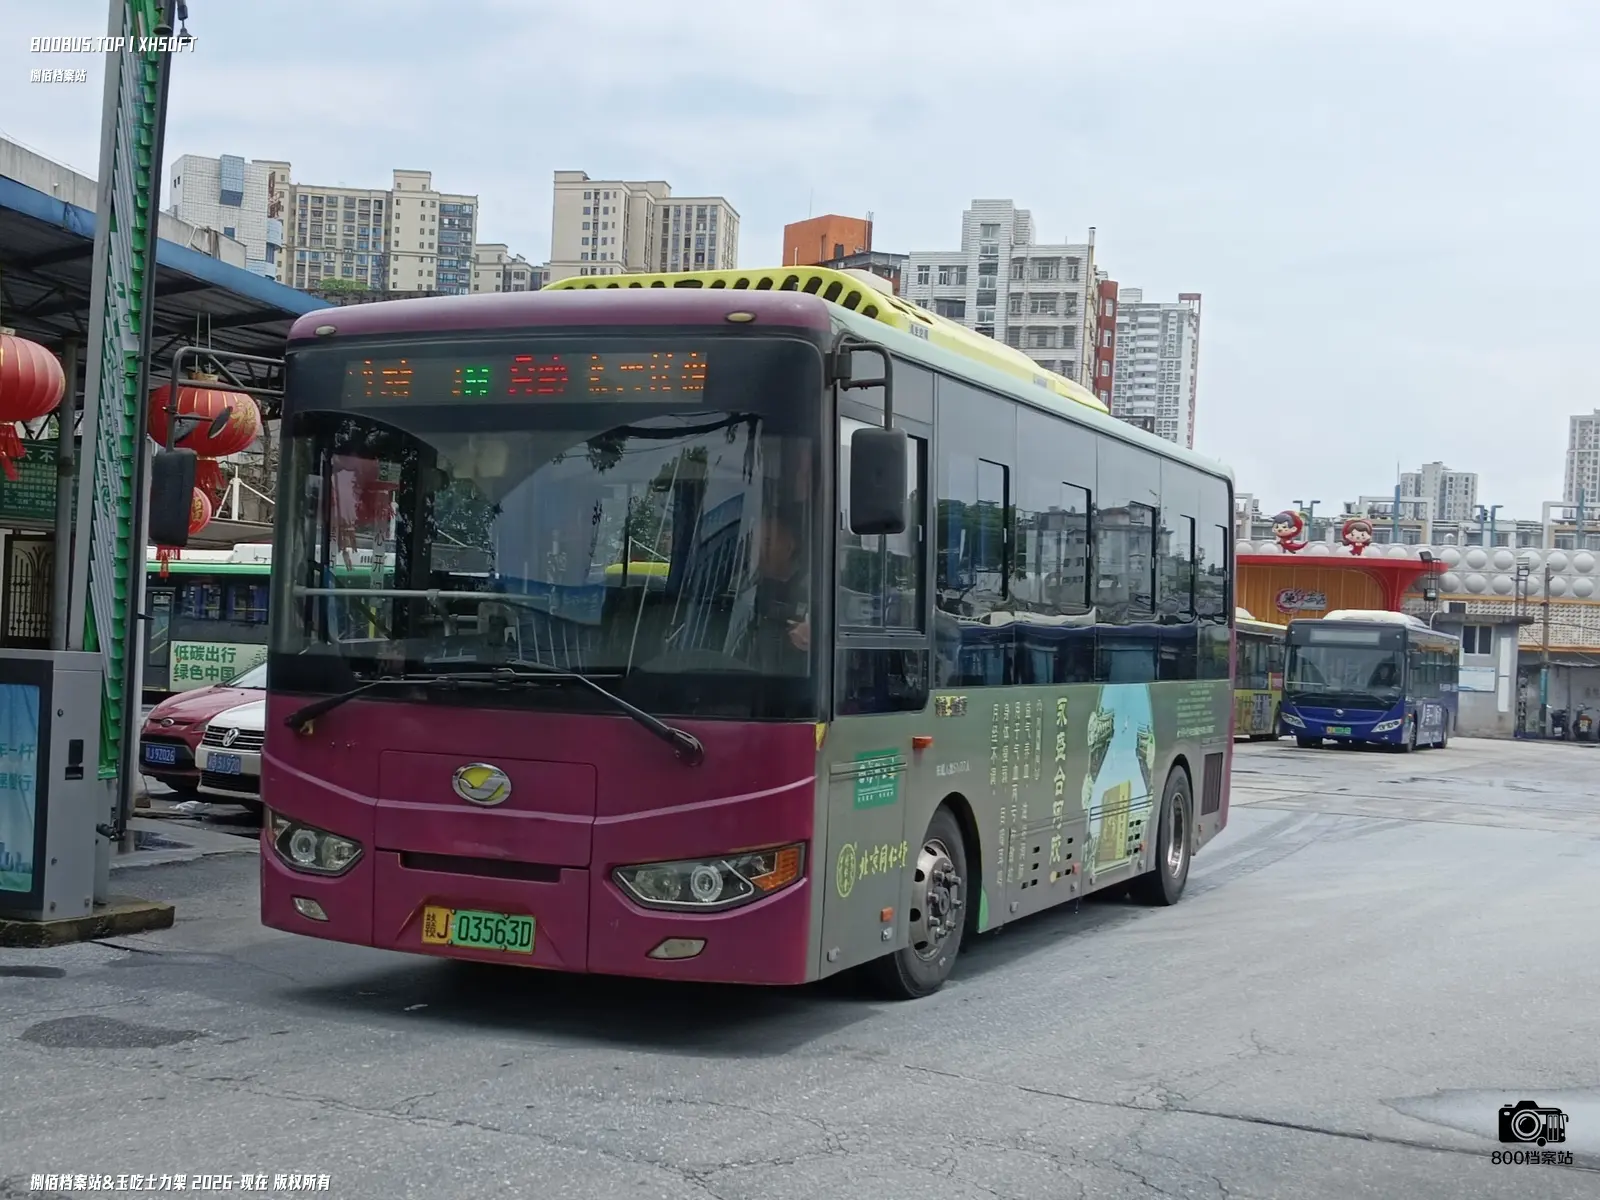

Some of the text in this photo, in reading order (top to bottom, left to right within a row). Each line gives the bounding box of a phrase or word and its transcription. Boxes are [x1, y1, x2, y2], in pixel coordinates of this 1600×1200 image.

[174, 644, 236, 663] 低碳出行
[173, 663, 235, 681] 绿色中国
